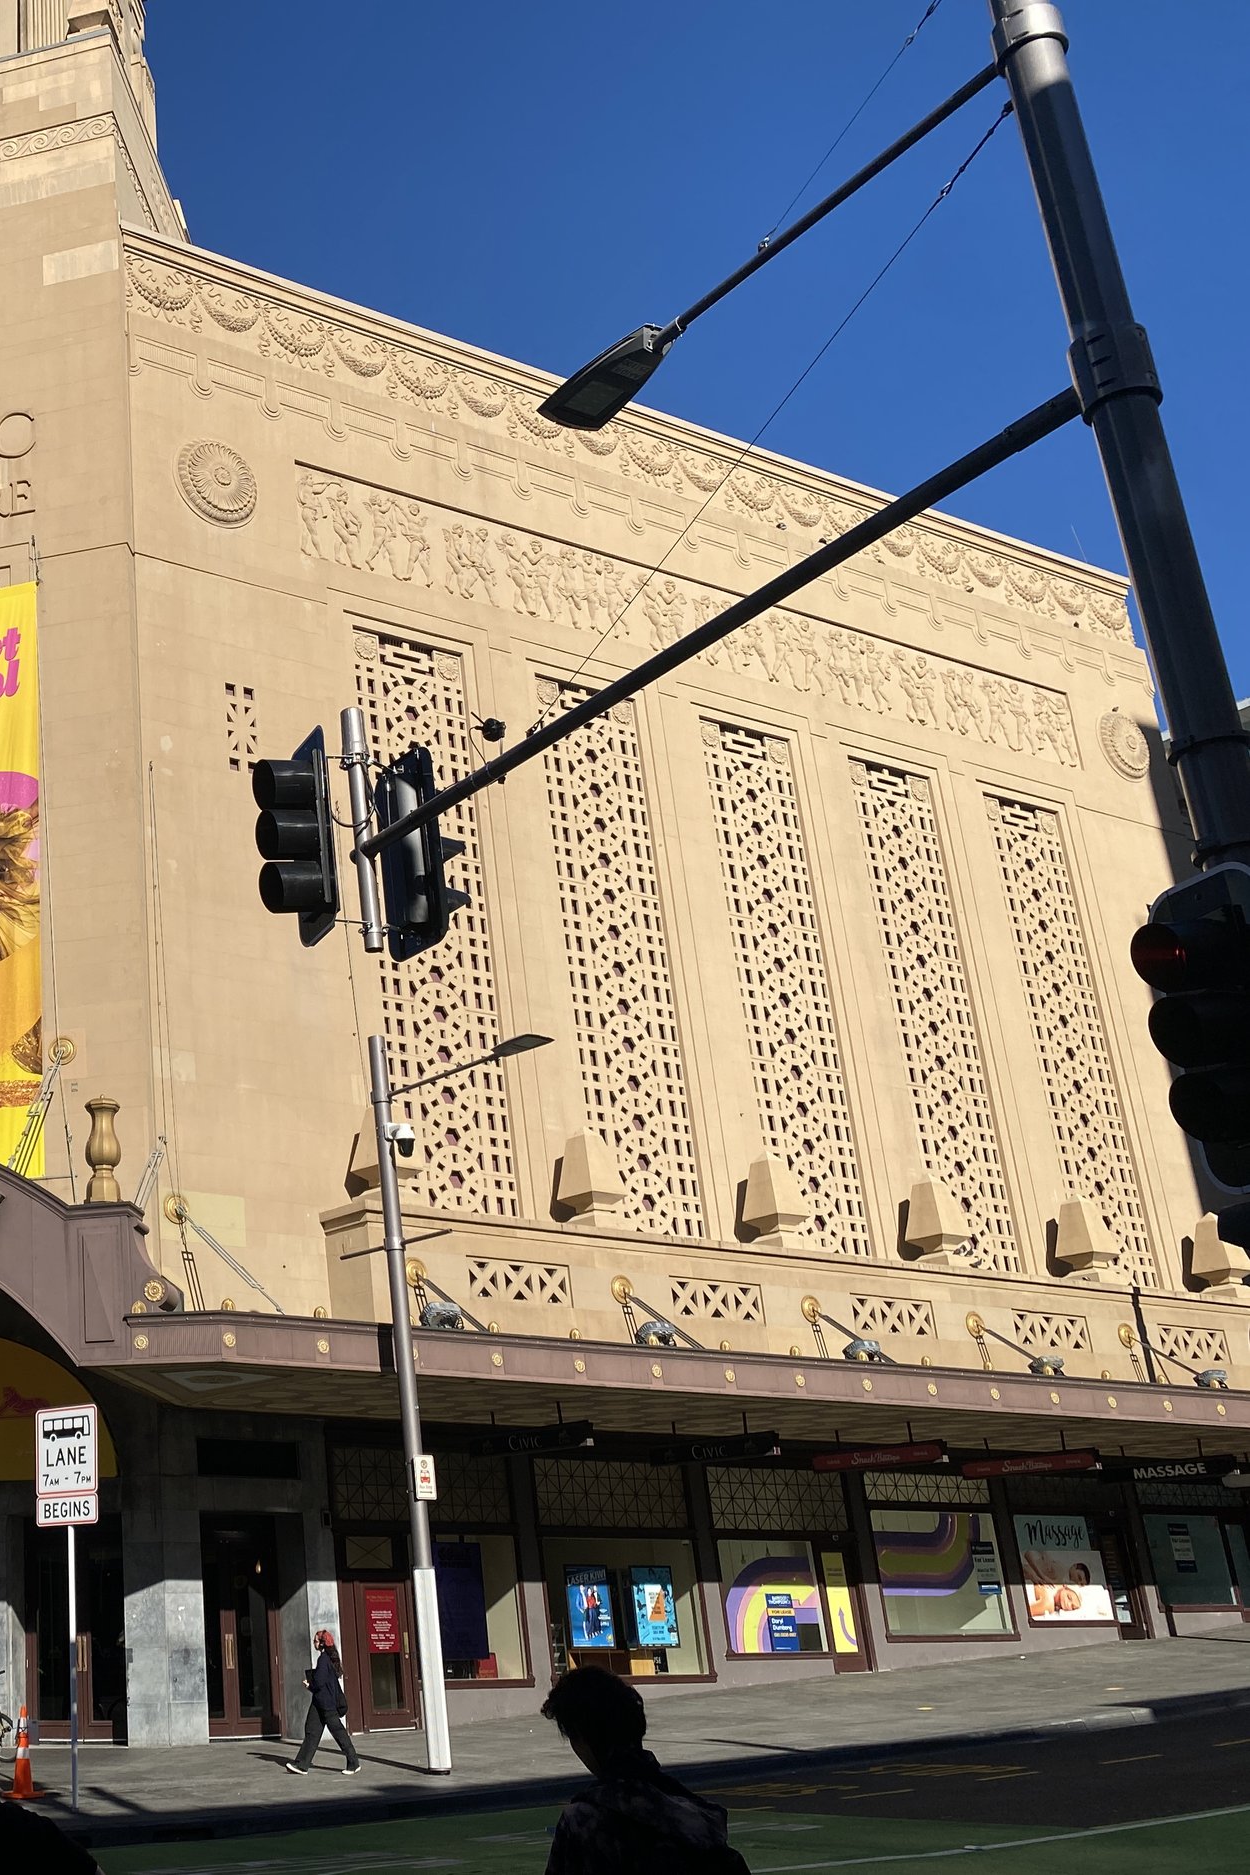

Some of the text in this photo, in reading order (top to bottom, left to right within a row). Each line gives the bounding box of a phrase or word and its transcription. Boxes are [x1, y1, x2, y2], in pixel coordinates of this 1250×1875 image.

[46, 1446, 87, 1467] LANE
[42, 1474, 59, 1487] 7AM
[74, 1471, 91, 1484] 7PM
[1133, 1462, 1207, 1480] MASSAGE
[43, 1500, 90, 1519] BEGINS
[1024, 1519, 1085, 1549] Massage
[566, 1569, 606, 1585] LASER KIWI
